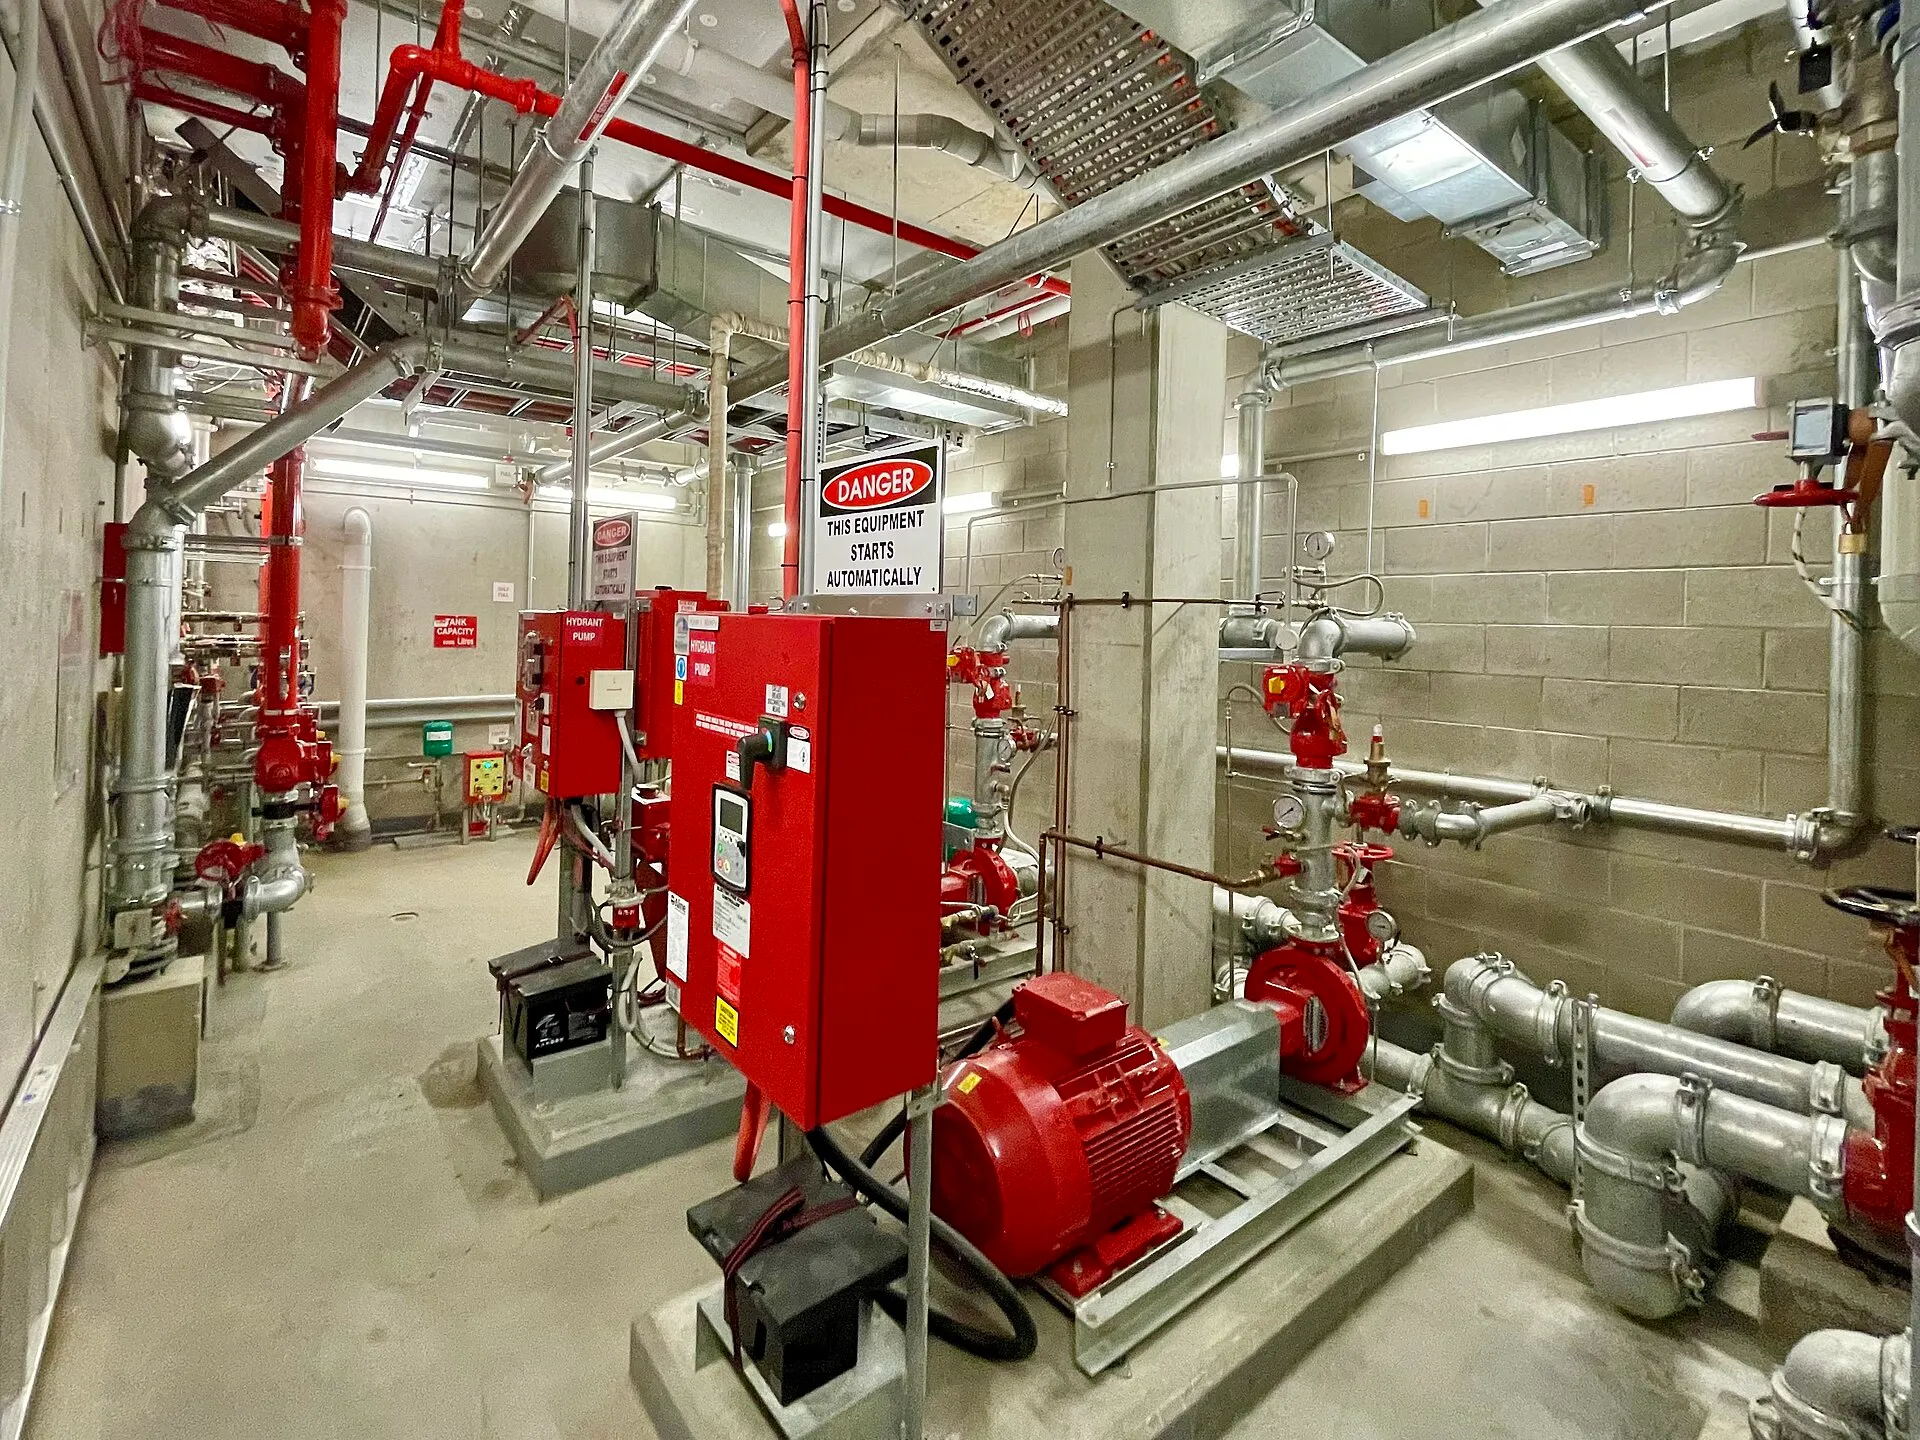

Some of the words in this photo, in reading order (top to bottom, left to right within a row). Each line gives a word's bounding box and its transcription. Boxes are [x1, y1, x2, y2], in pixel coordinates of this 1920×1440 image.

[838, 467, 914, 502] DANGER
[827, 518, 850, 537] THIS
[854, 509, 925, 534] EQUIPMENT
[597, 525, 627, 541] DANGER
[850, 541, 894, 562] STARTS
[827, 566, 922, 588] AUTOMATICALLY
[444, 618, 467, 626] TANK
[566, 617, 604, 627] HYDRANT
[436, 627, 475, 635] CAPACITY
[572, 632, 596, 641] PUMP
[690, 639, 716, 654] HYDRANT
[694, 662, 711, 677] PUMP
